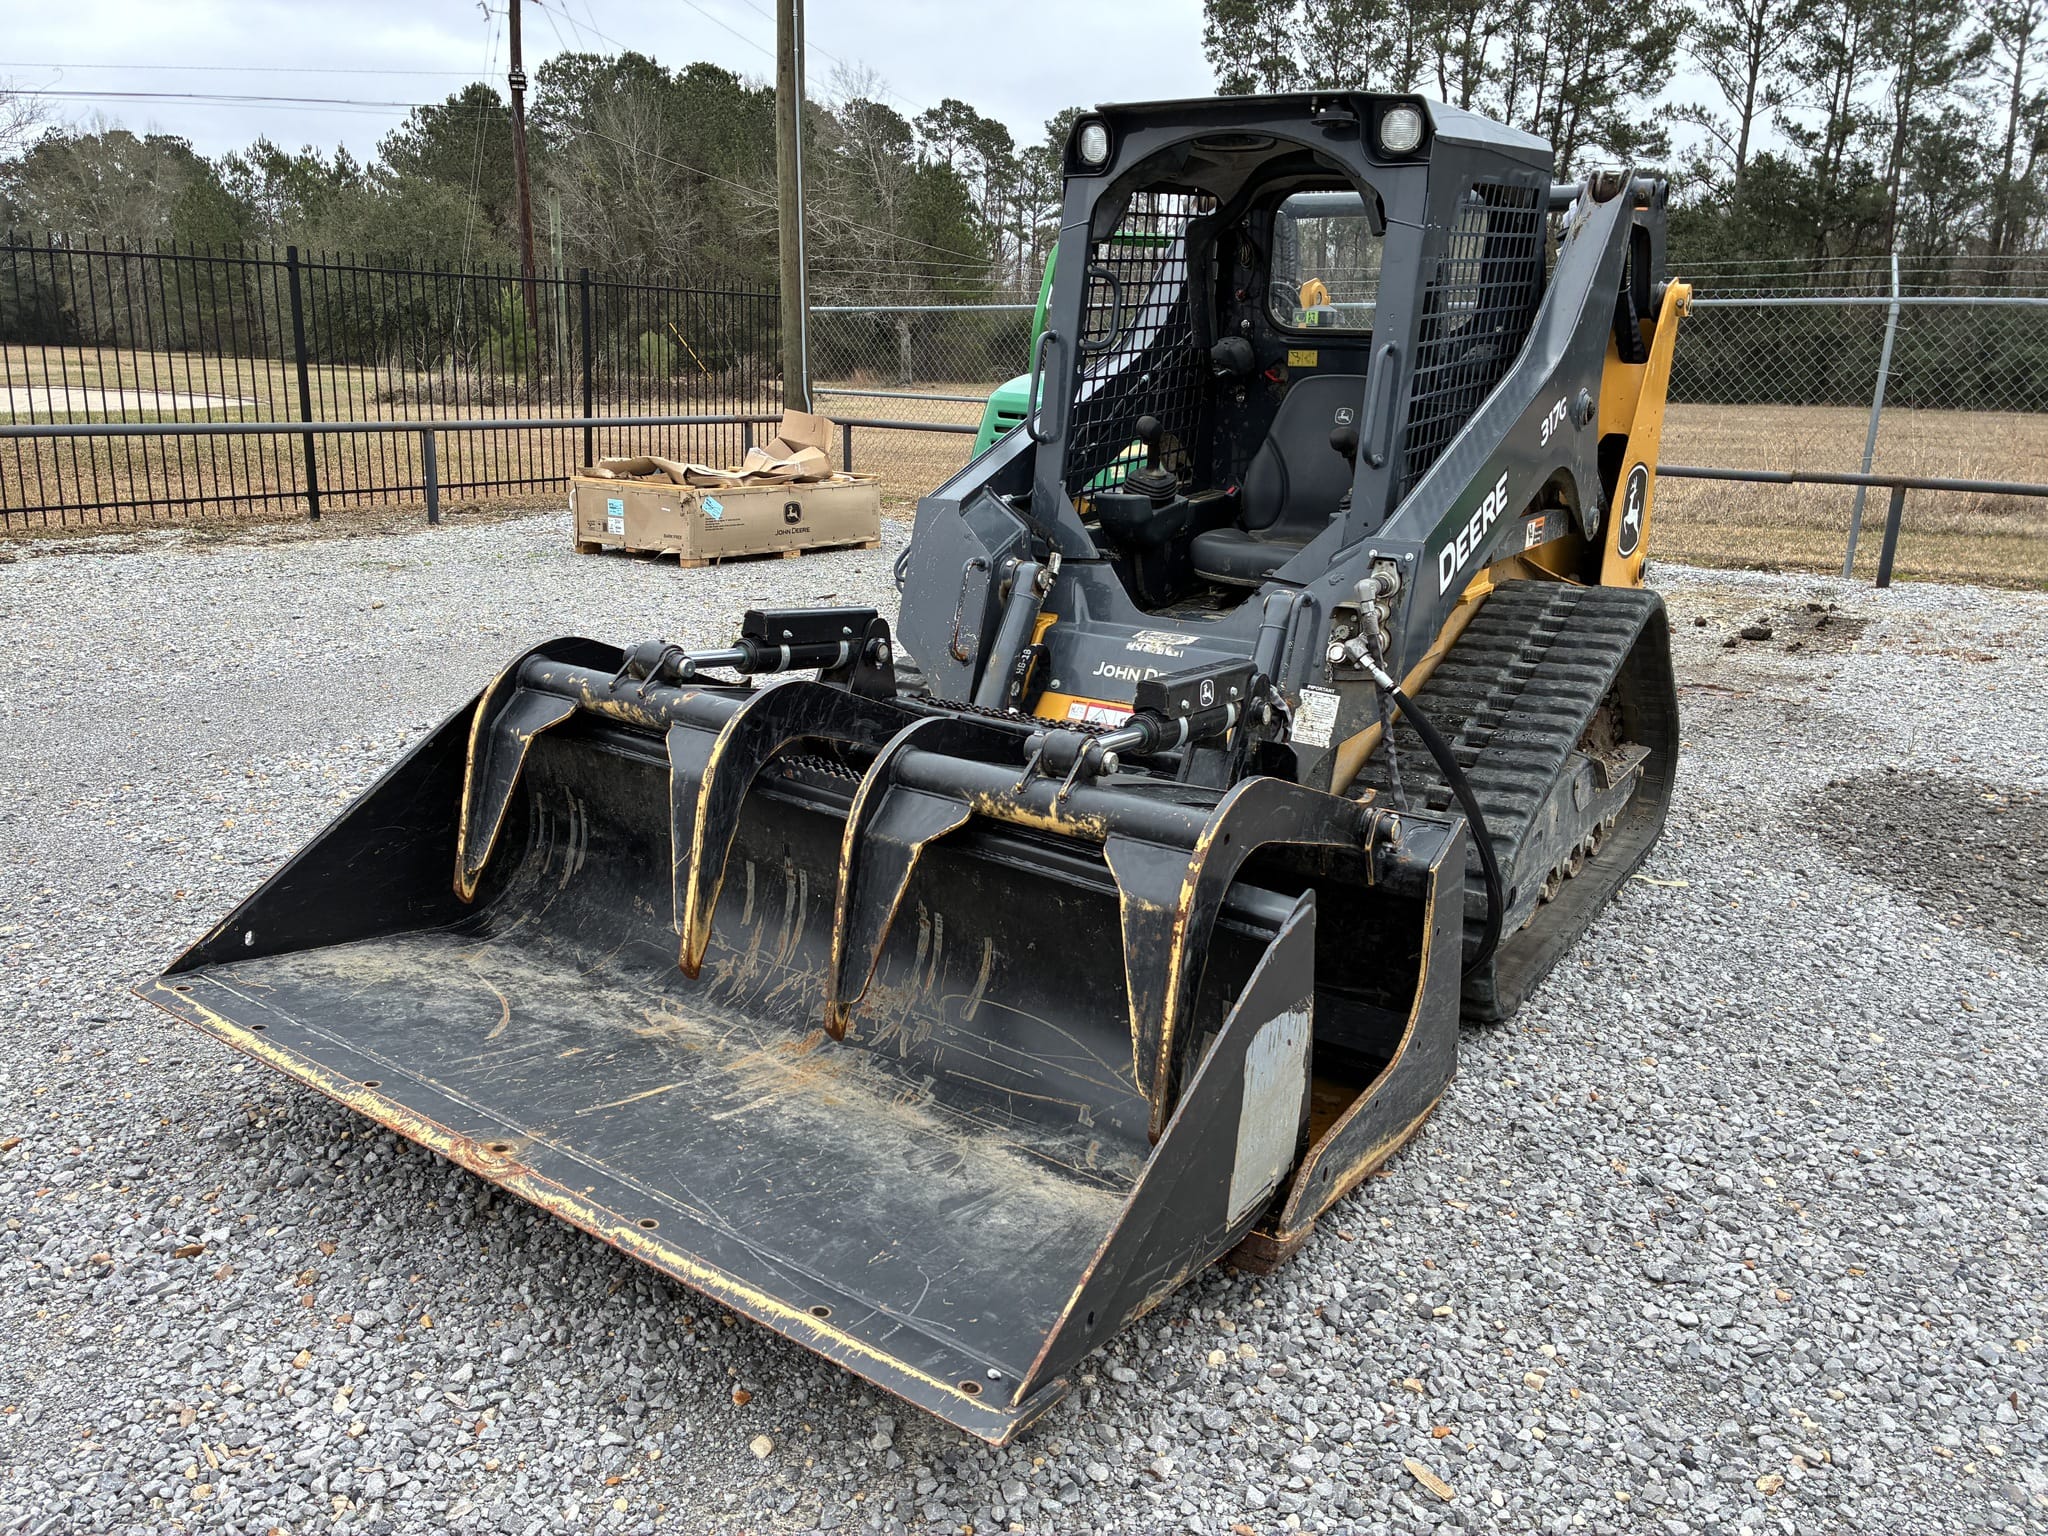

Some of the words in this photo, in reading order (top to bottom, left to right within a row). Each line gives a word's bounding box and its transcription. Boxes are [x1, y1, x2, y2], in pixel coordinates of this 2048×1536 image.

[1540, 396, 1567, 447] 317G
[792, 526, 811, 535] DEERE
[1439, 471, 1508, 596] DEERE
[1093, 661, 1141, 681] JOHN
